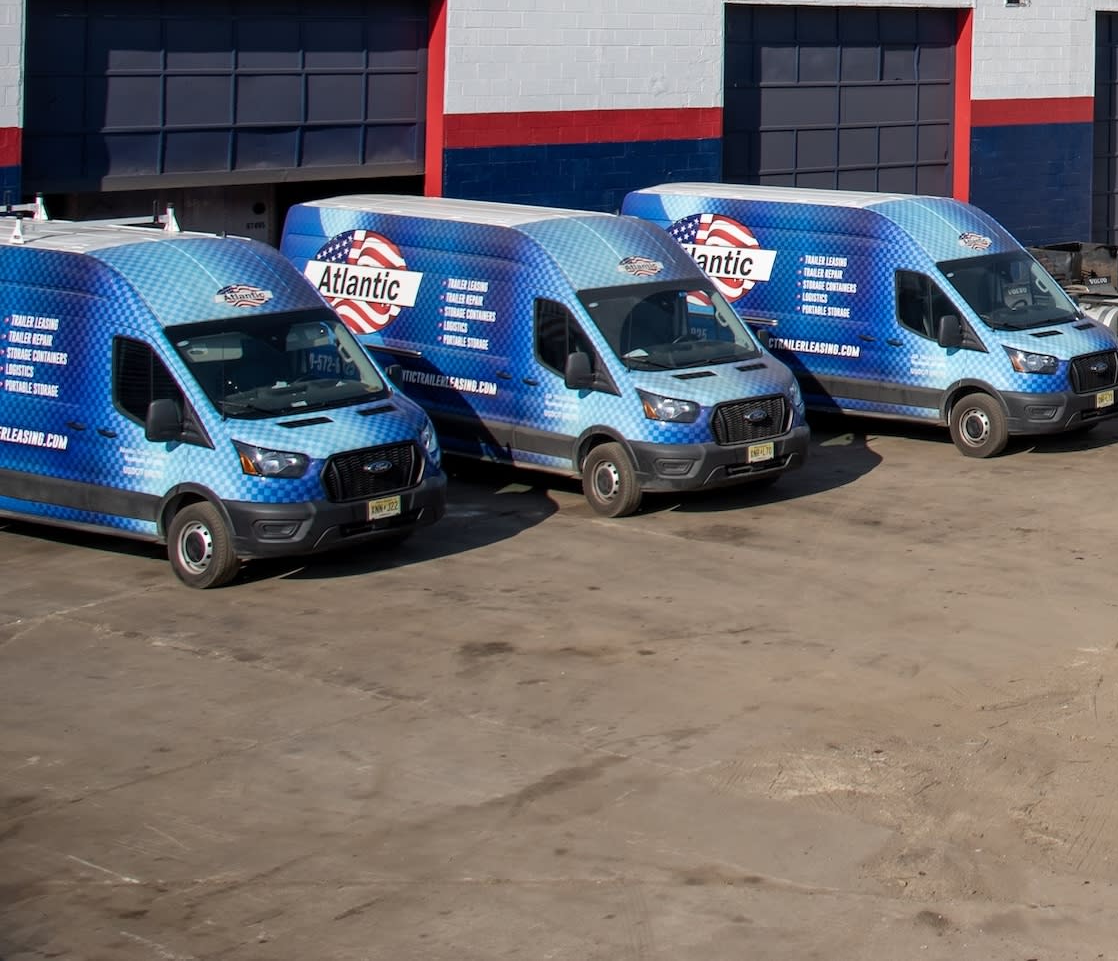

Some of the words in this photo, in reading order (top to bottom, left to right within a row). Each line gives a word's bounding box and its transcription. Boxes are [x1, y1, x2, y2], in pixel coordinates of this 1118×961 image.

[691, 248, 753, 276] antic
[805, 255, 825, 266] TRAILER
[826, 256, 847, 268] LEASING
[804, 267, 824, 278] TRAILER
[825, 268, 843, 279] REPAIR
[318, 265, 400, 301] Atlantic
[448, 278, 467, 290] TRAILER
[468, 280, 488, 292] LEASING
[803, 280, 825, 290] STORAGE
[826, 281, 857, 293] CONTAINERS
[1089, 277, 1108, 285] VOLVO
[224, 291, 265, 301] Atlantic
[446, 292, 465, 304] TRAILER
[466, 294, 483, 306] REPAIR
[802, 292, 828, 303] LOGISTICS
[444, 306, 466, 319] STORAGE
[466, 308, 496, 322] CONTAINERS
[802, 304, 827, 316] PORTABLE
[828, 306, 850, 318] STORAGE
[11, 314, 34, 328] TRAILER
[34, 316, 59, 331] LEASING
[443, 320, 468, 333] LOGISTICS
[9, 330, 32, 344] TRAILER
[32, 332, 53, 347] REPAIR
[443, 334, 466, 347] PORTABLE
[467, 337, 488, 350] STORAGE
[7, 347, 32, 361] STORAGE
[32, 349, 68, 365] CONTAINERS
[5, 363, 34, 378] LOGISTICS
[5, 379, 32, 394] PORTABLE
[32, 382, 59, 397] STORAGE
